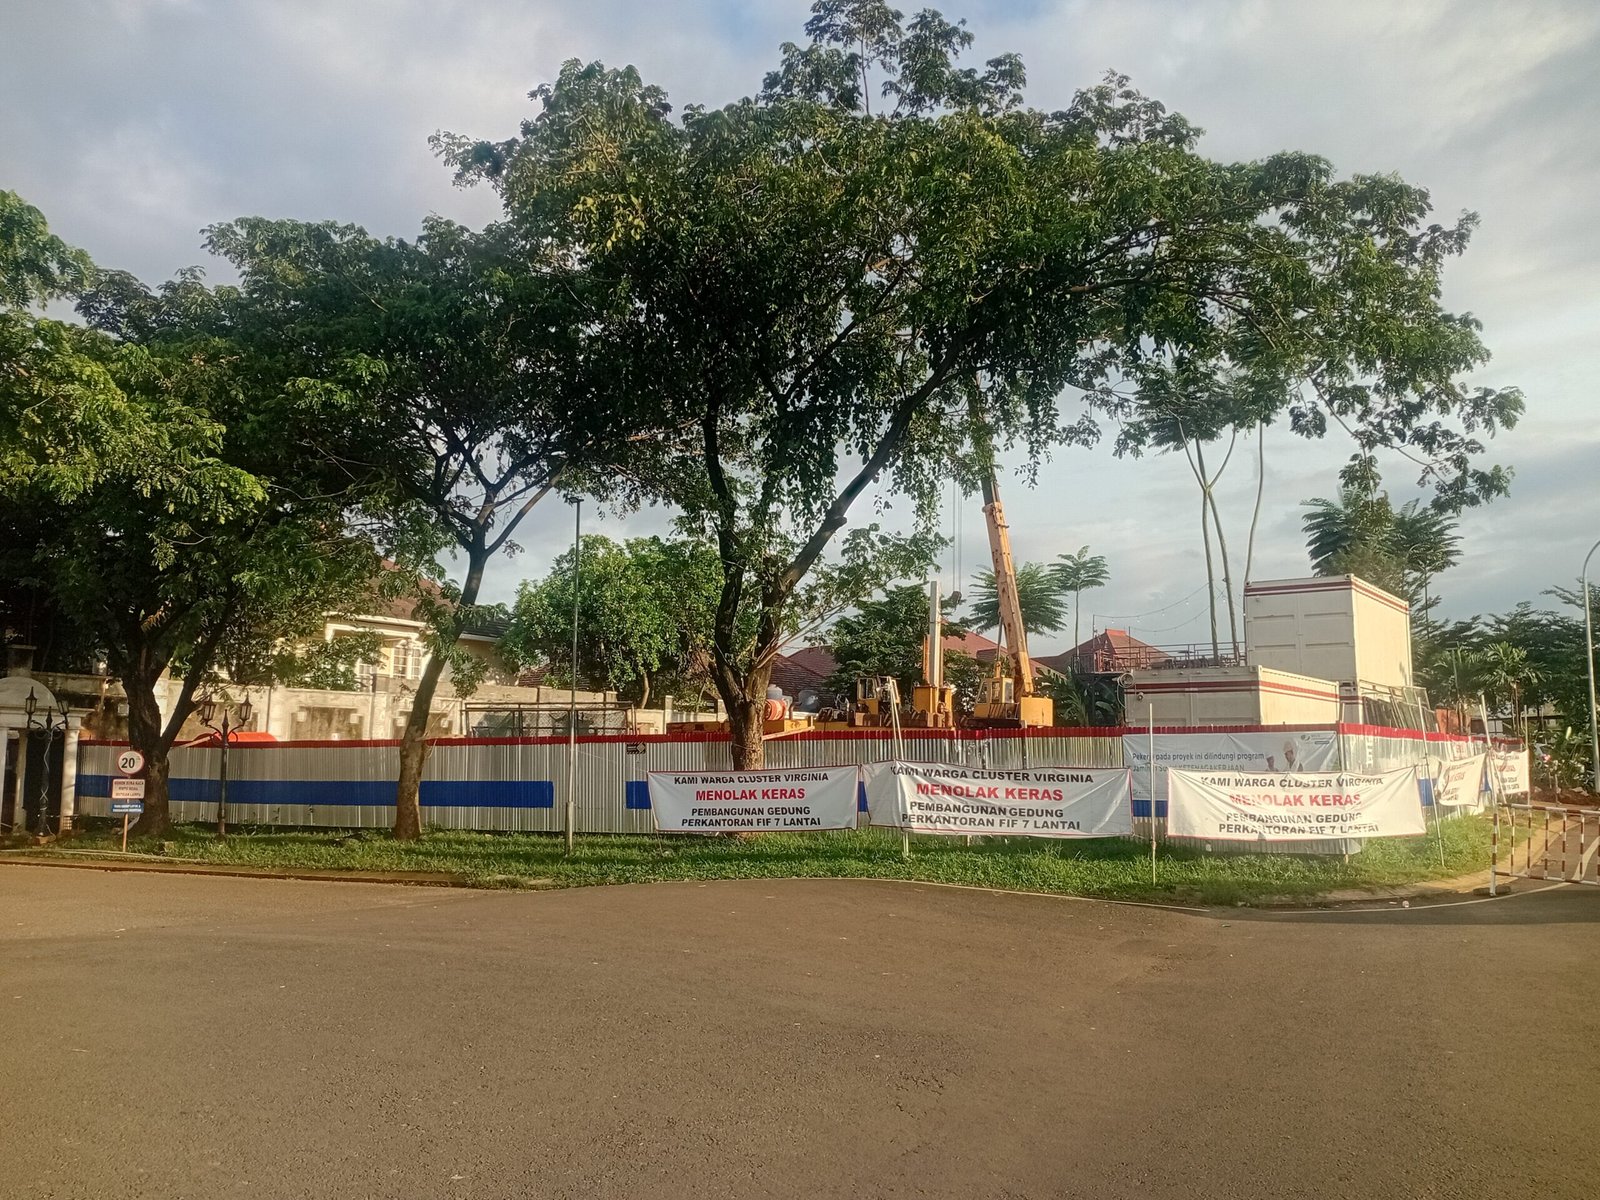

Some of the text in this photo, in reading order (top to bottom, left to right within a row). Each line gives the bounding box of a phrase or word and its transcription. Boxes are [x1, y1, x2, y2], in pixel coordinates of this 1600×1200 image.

[1172, 752, 1194, 761] proyek
[121, 757, 135, 769] 20
[674, 772, 829, 784] KAMI WARGA CLUSTER VIRGINIA
[890, 766, 1094, 783] KAMI WARGA CLUSTER VIRGINIA
[1234, 778, 1276, 787] WARGA
[1279, 778, 1333, 788] CLUSTER
[696, 788, 805, 801] MENOLAK KERAS
[916, 783, 1064, 801] MENOLAK KERAS
[1309, 793, 1362, 806] KERAS
[691, 806, 811, 816] PEMBANGUNAN GEDUNG
[909, 801, 1064, 818] PEMBANGUNAN GEDUNG
[681, 817, 821, 827] PERKANTORAN FIF 7 LANTAI
[901, 813, 1080, 830] PERKANTORAN FIF 7 LANTAI
[1329, 825, 1336, 834] 7
